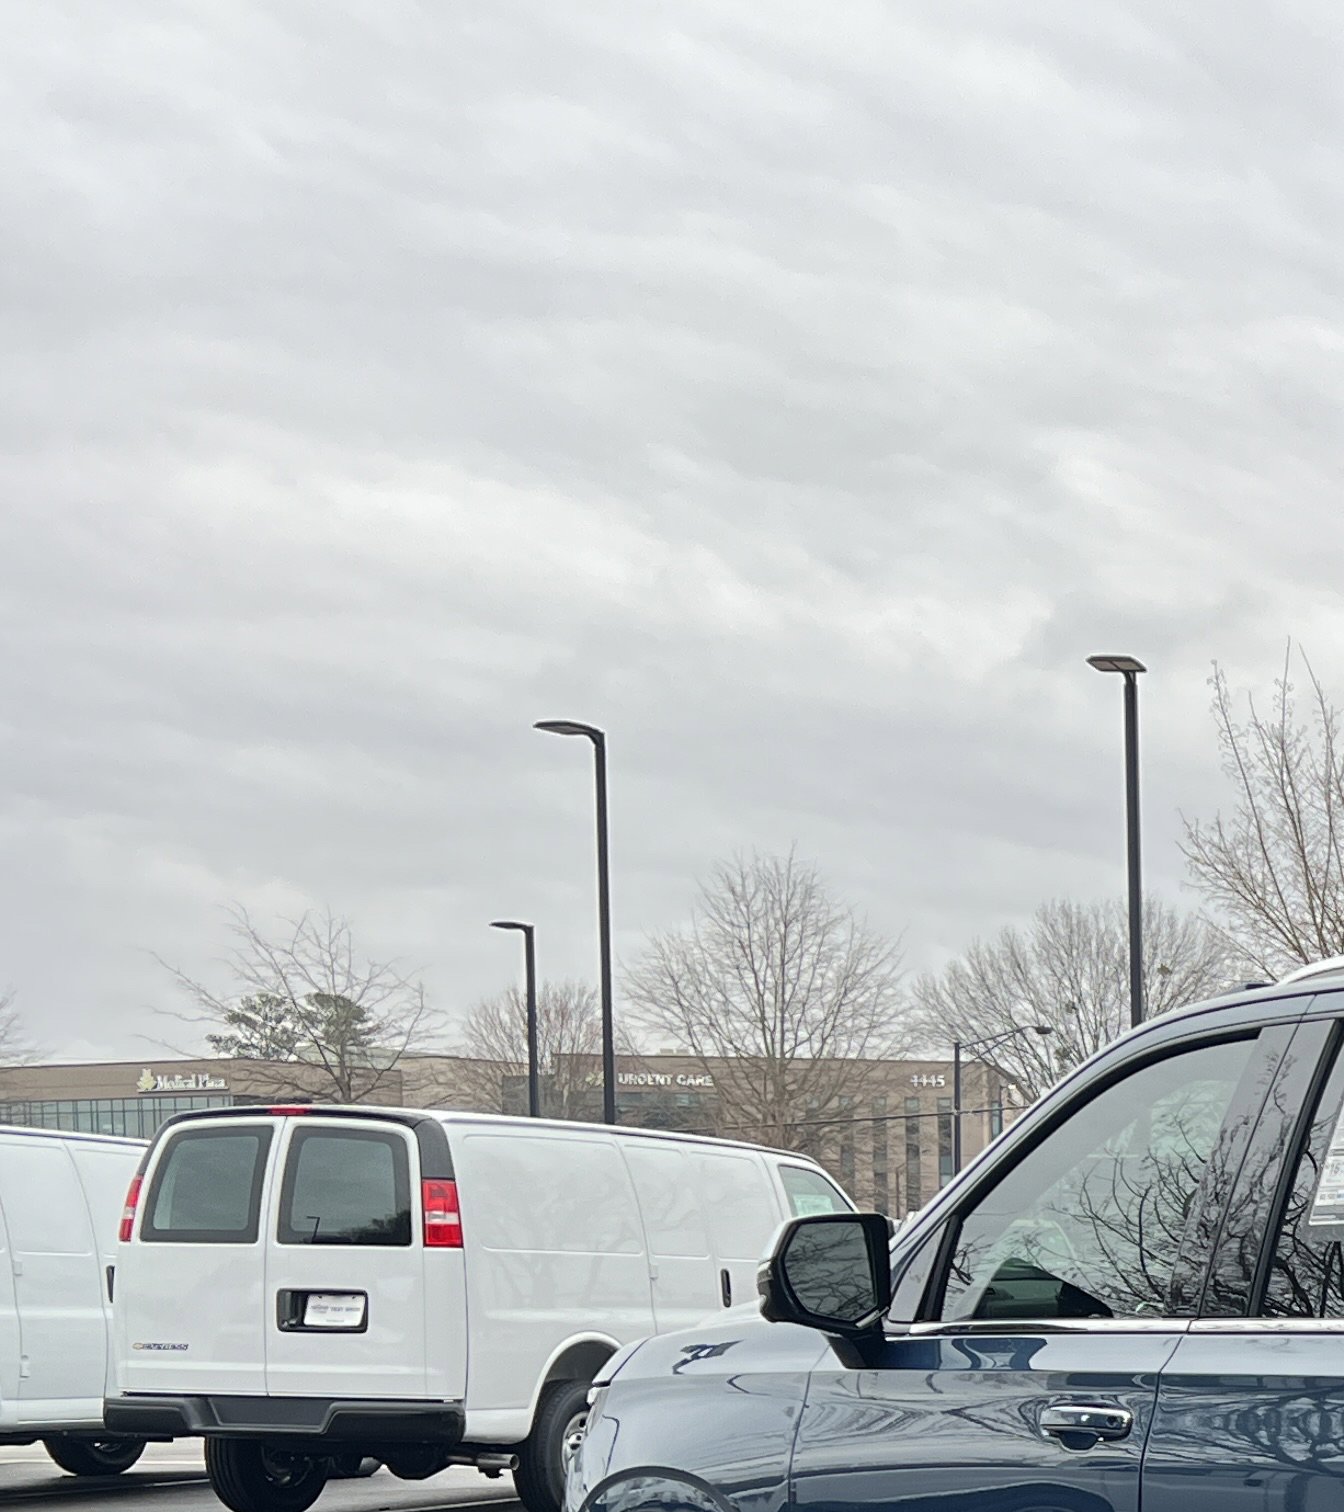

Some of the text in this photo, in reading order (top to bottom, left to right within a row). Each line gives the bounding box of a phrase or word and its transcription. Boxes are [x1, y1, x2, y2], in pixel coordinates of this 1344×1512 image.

[157, 1073, 196, 1090] Medical
[617, 1073, 715, 1087] URGENT CARE
[909, 1074, 945, 1088] 4445
